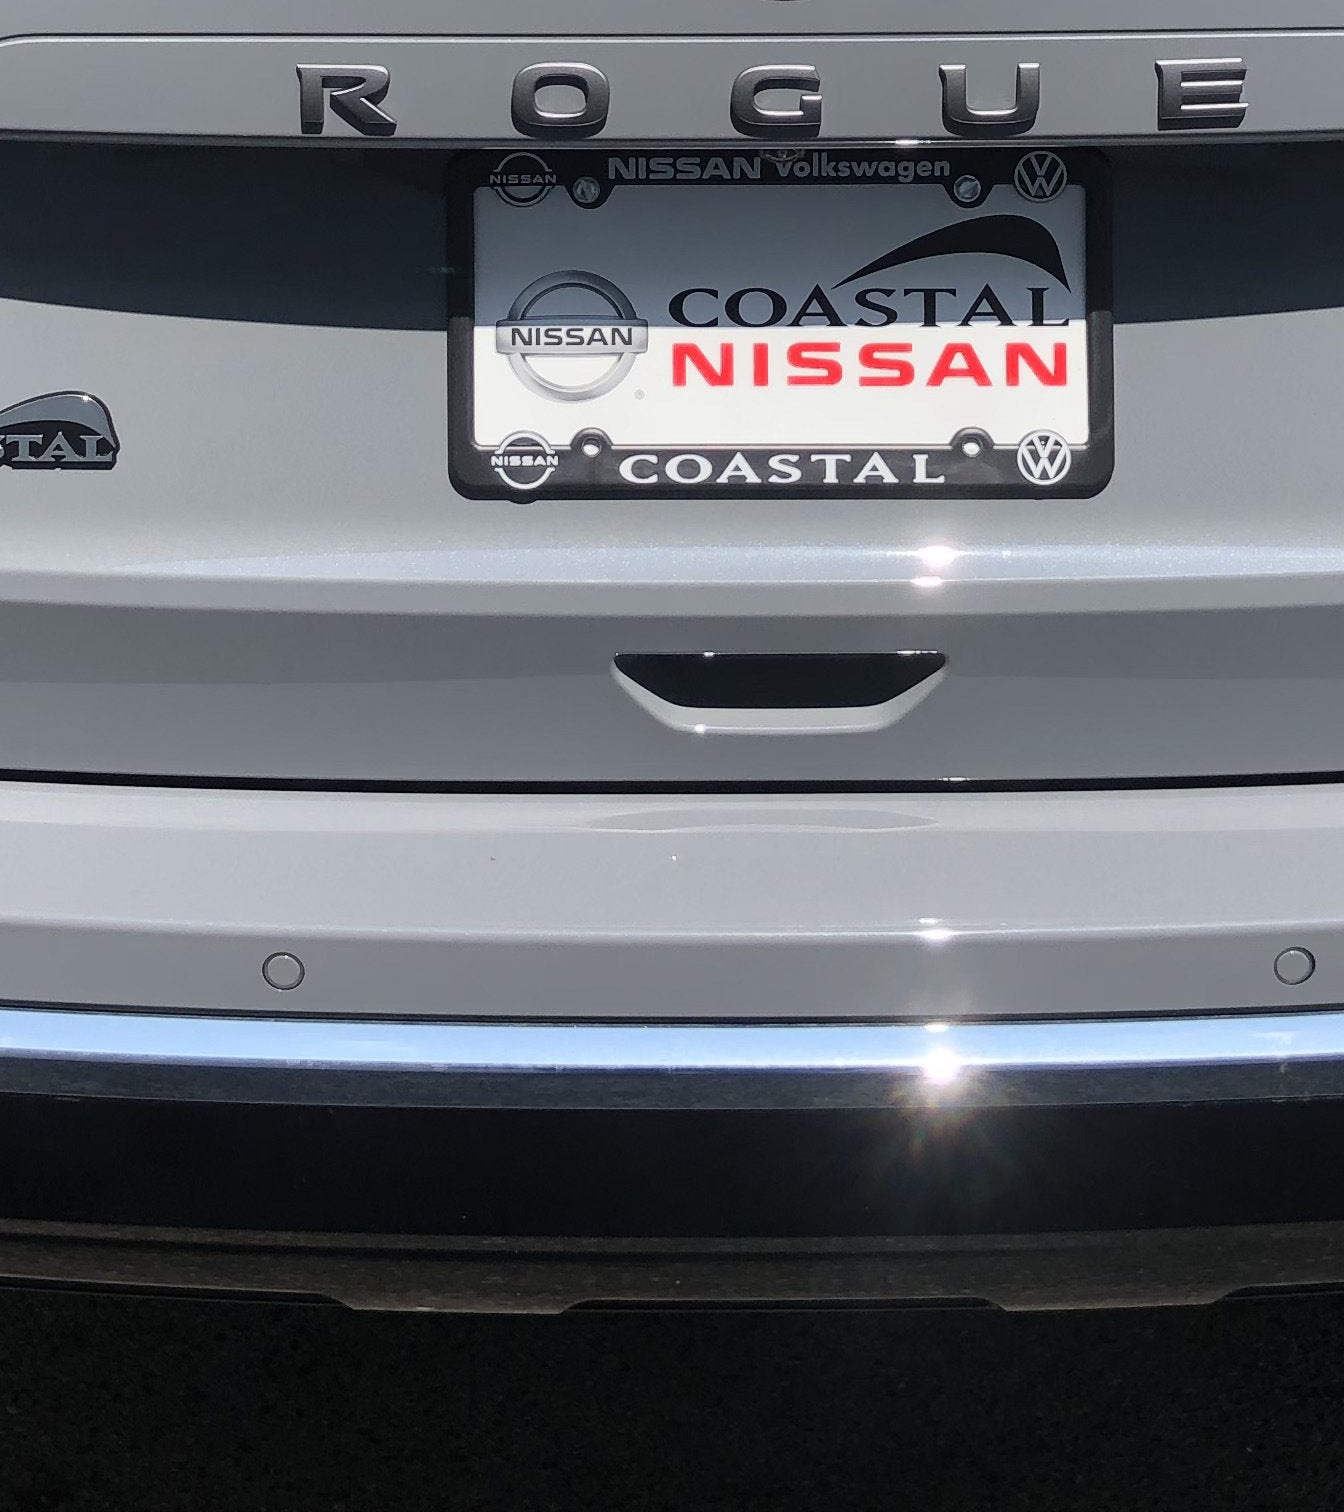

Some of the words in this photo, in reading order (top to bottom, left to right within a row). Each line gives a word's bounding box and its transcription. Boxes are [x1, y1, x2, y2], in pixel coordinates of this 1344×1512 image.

[296, 57, 1250, 137] ROGUE
[489, 174, 557, 184] NISSAN
[608, 156, 761, 180] NISSAN
[774, 152, 950, 183] Volkswagen
[668, 284, 1071, 328] COASTAL
[511, 326, 633, 346] NISSAN
[672, 341, 1067, 387] NISSAN
[490, 455, 559, 466] NISSAN
[619, 451, 945, 484] COASTAL
